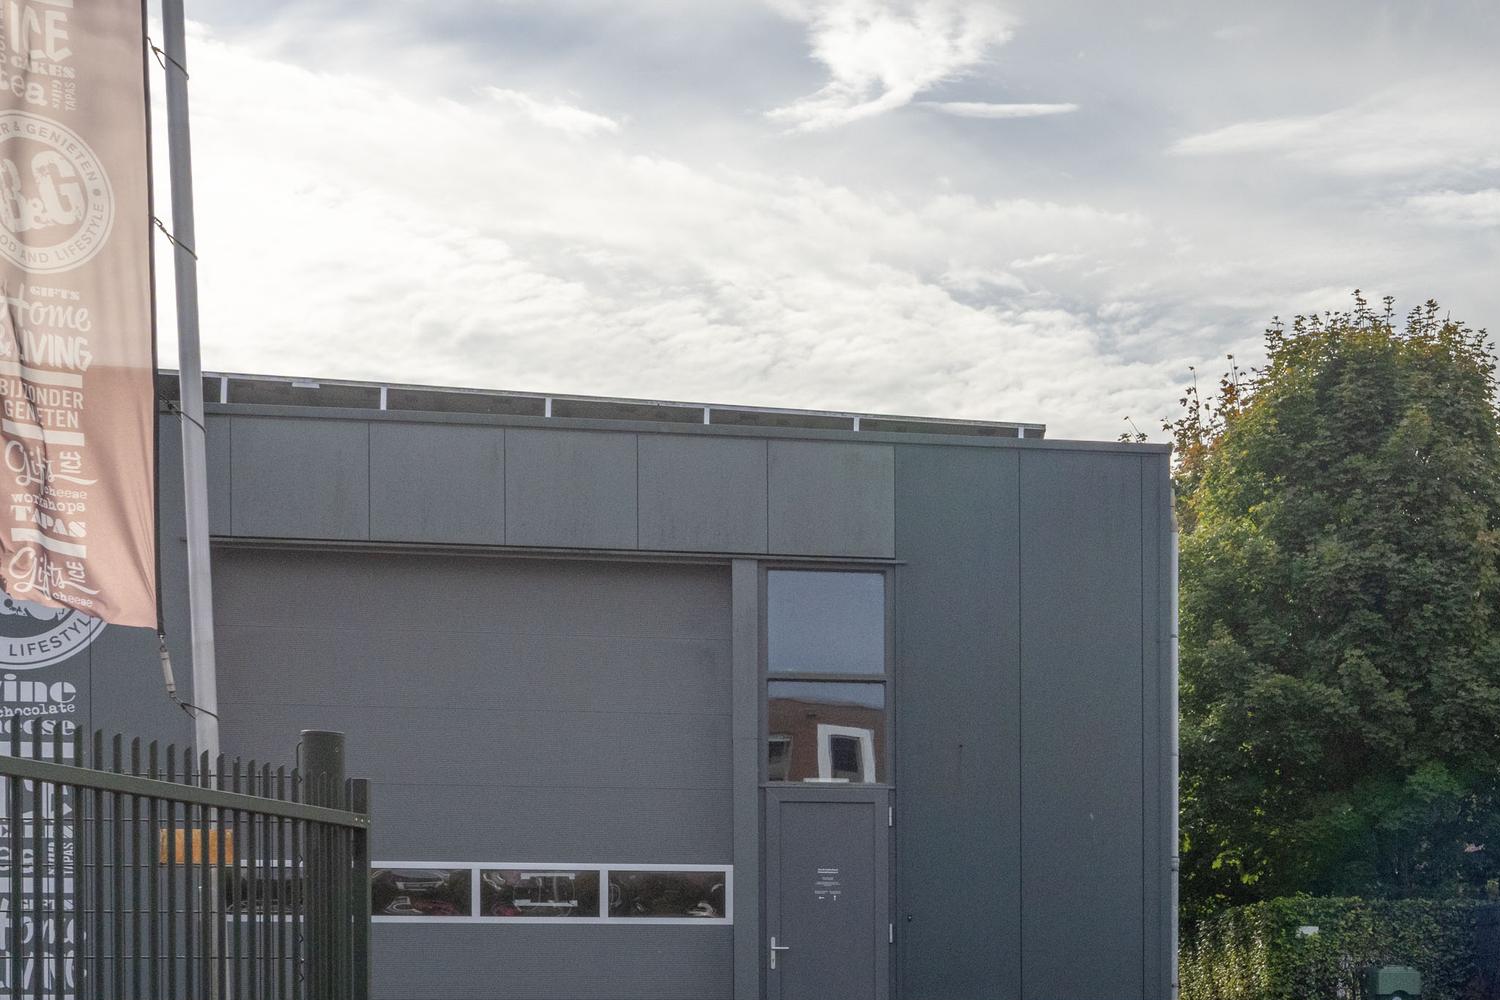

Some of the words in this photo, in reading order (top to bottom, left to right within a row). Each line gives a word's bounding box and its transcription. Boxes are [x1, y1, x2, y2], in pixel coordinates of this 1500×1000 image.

[26, 123, 98, 182] GENIETEN
[55, 203, 104, 261] LIFESTYLE
[20, 329, 93, 372] IVING
[60, 451, 81, 474] ICE
[10, 505, 87, 538] TAPAS
[9, 546, 100, 600] Gifts
[66, 560, 86, 584] ICE
[53, 591, 94, 608] cheese
[9, 616, 91, 657] LIFESTYL
[0, 673, 77, 703] ine
